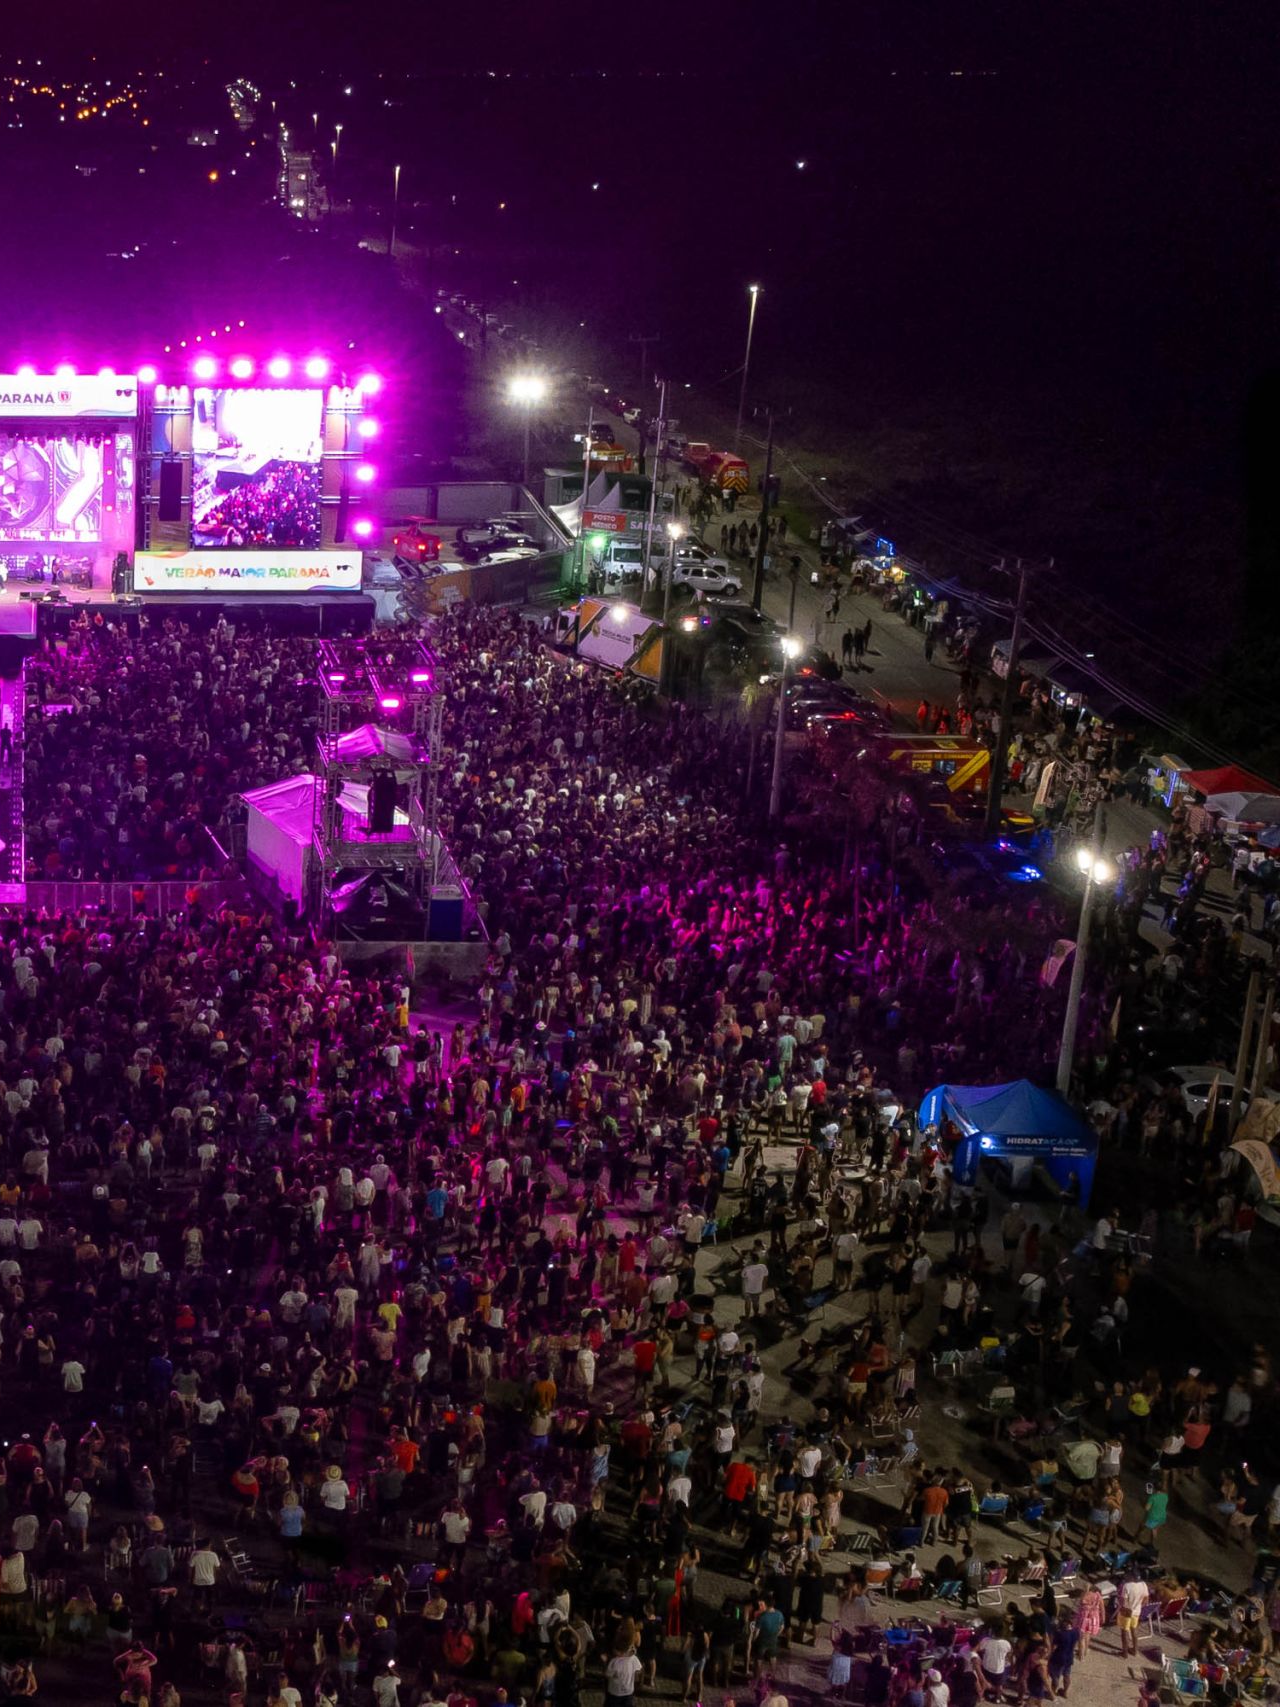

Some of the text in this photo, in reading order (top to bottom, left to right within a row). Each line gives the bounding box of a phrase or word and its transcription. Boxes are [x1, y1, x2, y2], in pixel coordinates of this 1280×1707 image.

[592, 513, 616, 523] POSTO
[629, 520, 663, 533] SAÍDA
[165, 565, 330, 579] VERÃO MAIOR PARANÁ
